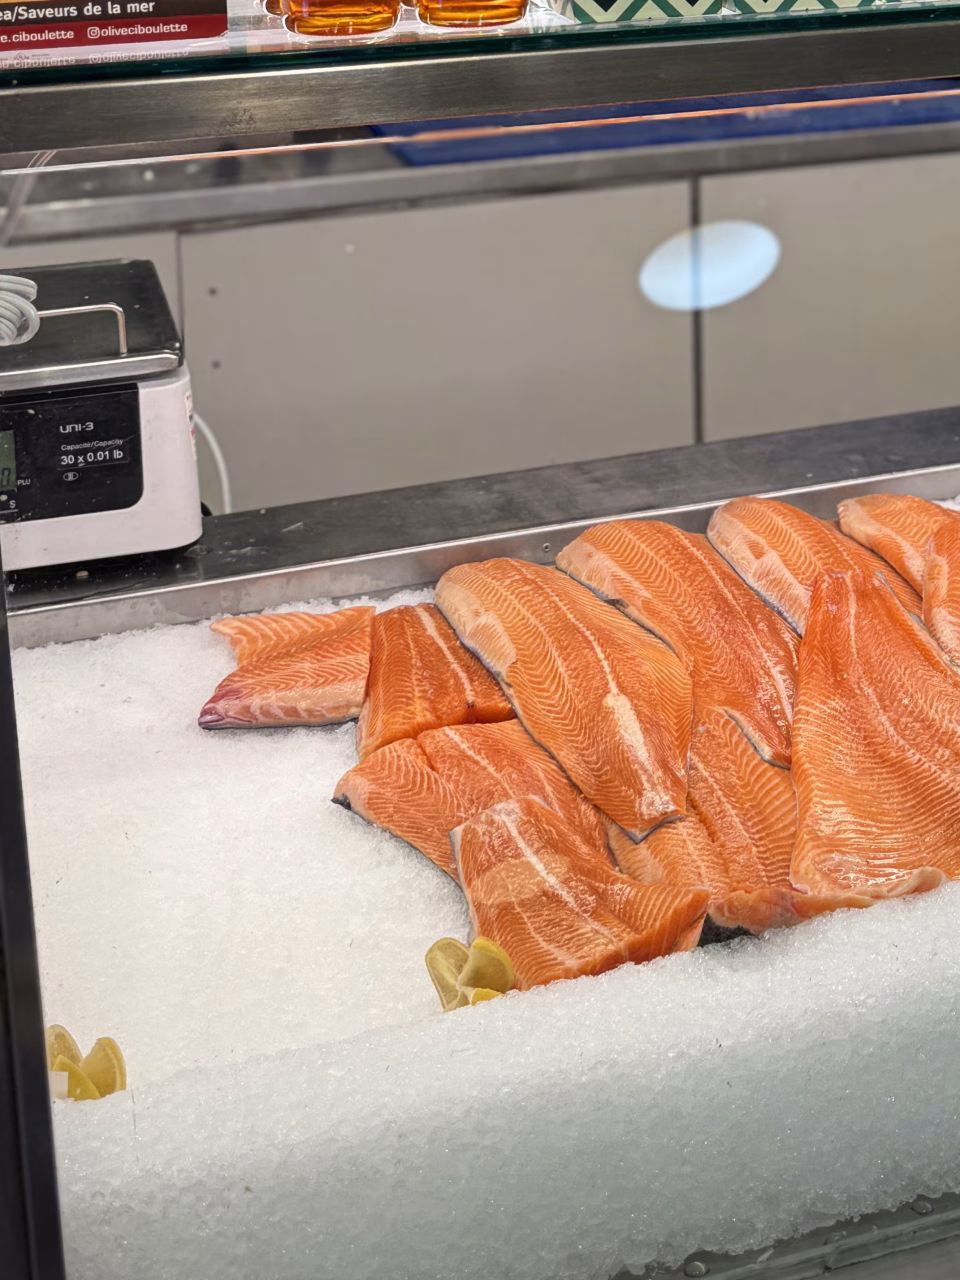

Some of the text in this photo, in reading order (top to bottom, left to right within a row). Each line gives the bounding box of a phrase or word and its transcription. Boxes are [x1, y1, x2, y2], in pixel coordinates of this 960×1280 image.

[83, 2, 102, 16] de
[107, 0, 121, 15] la
[127, 0, 156, 13] mer
[61, 449, 123, 465] 30 x 0.01 lb
[17, 478, 31, 486] PLU
[9, 500, 16, 509] S
